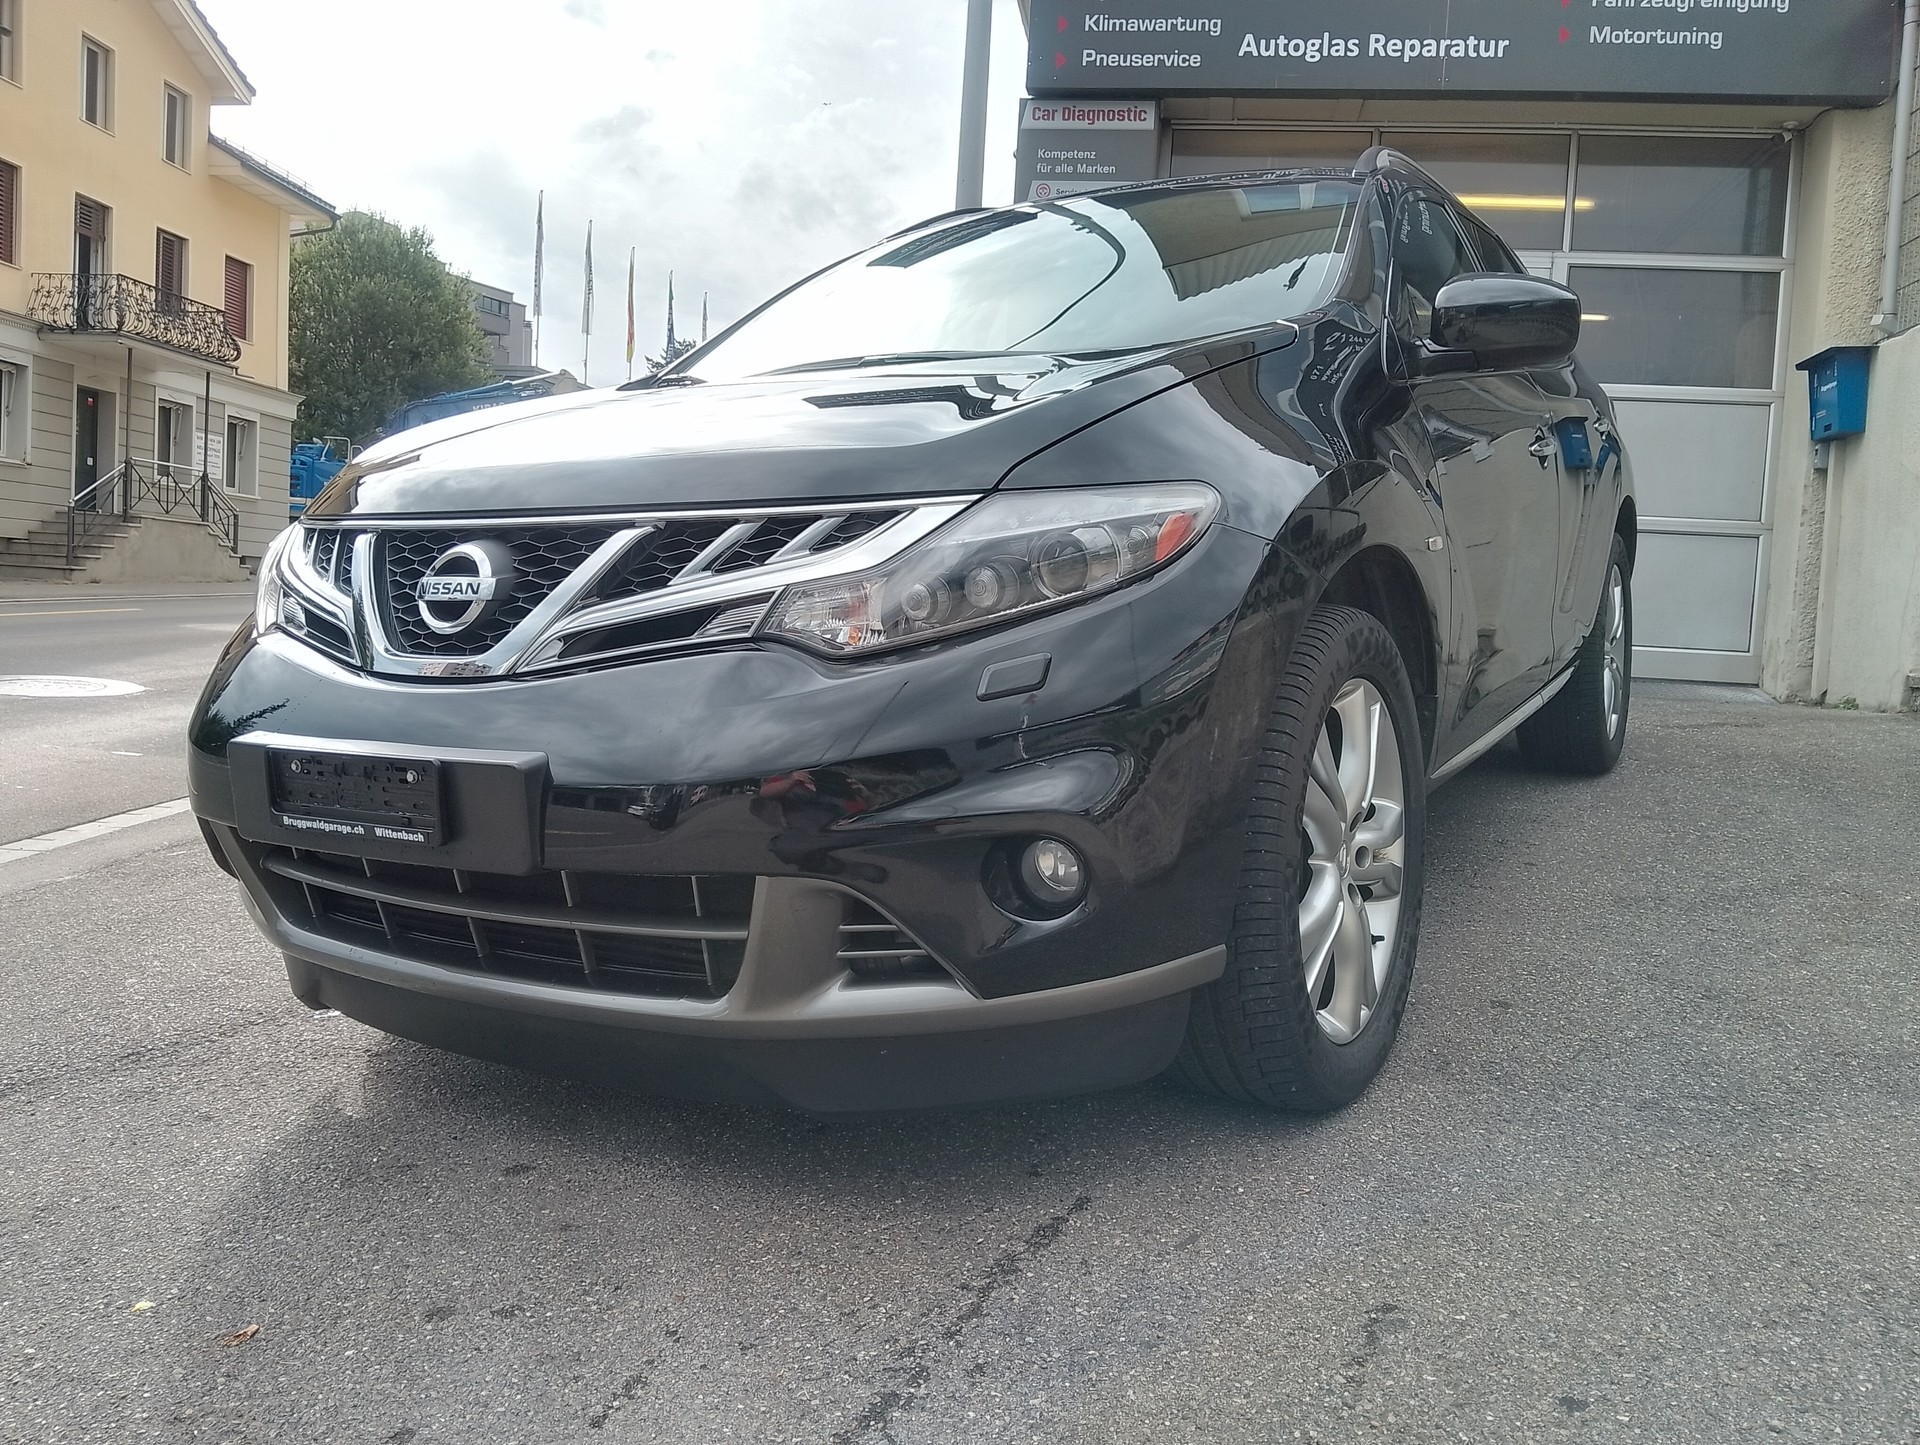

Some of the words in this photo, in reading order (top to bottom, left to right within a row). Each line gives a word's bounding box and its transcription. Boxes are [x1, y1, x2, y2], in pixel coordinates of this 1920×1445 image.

[1084, 14, 1222, 36] Klimawartung
[1238, 32, 1360, 62] Autoglas
[1368, 33, 1510, 62] Reparatur
[1589, 25, 1723, 49] Motortuning
[1081, 49, 1202, 67] Pneuservice
[1031, 106, 1058, 121] Car
[1061, 105, 1148, 125] Diagnostic
[1037, 148, 1096, 161] Kompetenz
[1036, 162, 1052, 173] für
[1055, 163, 1073, 174] alle
[1077, 163, 1116, 174] Marken
[417, 581, 482, 596] NISSAN
[282, 815, 366, 836] Bruggwaldgarage.ch
[374, 826, 425, 843] Wittenbach
